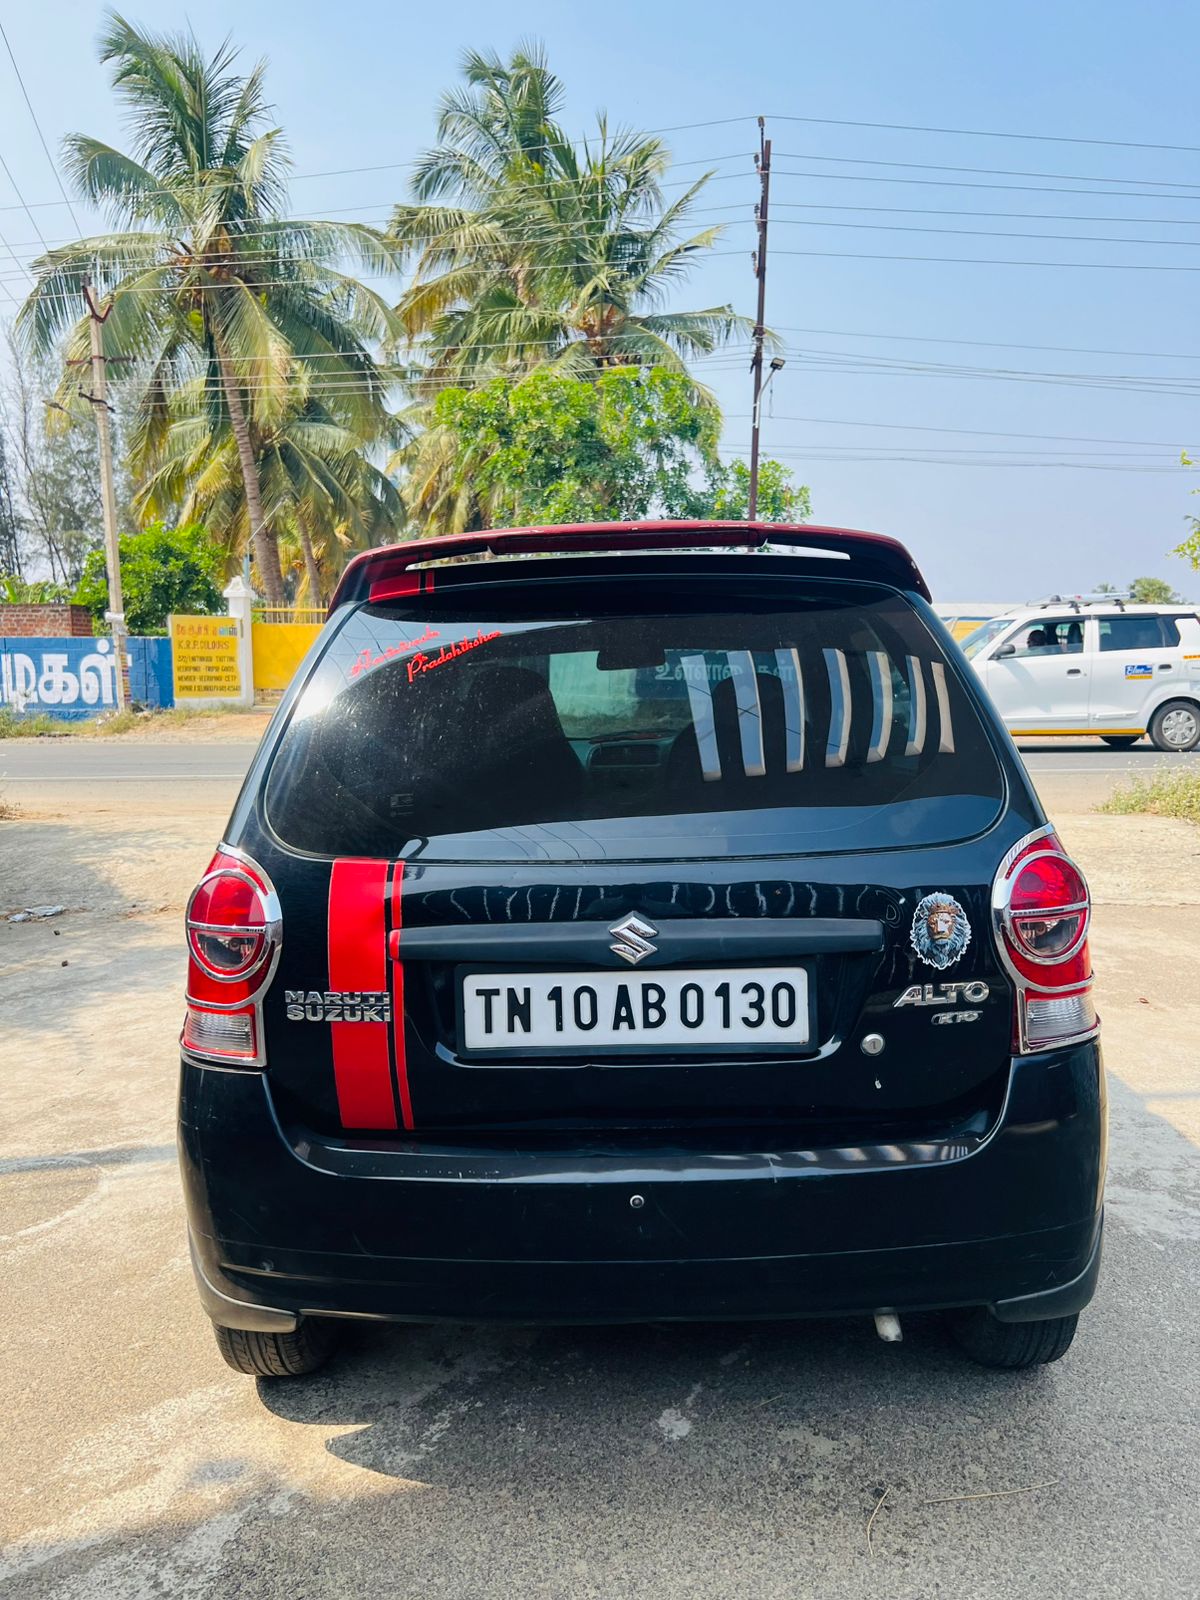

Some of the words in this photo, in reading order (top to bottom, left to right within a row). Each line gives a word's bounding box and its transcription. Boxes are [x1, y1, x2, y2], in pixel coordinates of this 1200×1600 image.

[284, 990, 391, 1005] MARUTI
[893, 981, 990, 1008] ALTO
[286, 1004, 391, 1022] SUZUKI
[475, 987, 532, 1034] TN
[547, 985, 598, 1032] 10
[612, 983, 667, 1031] AB
[680, 981, 797, 1029] 0130
